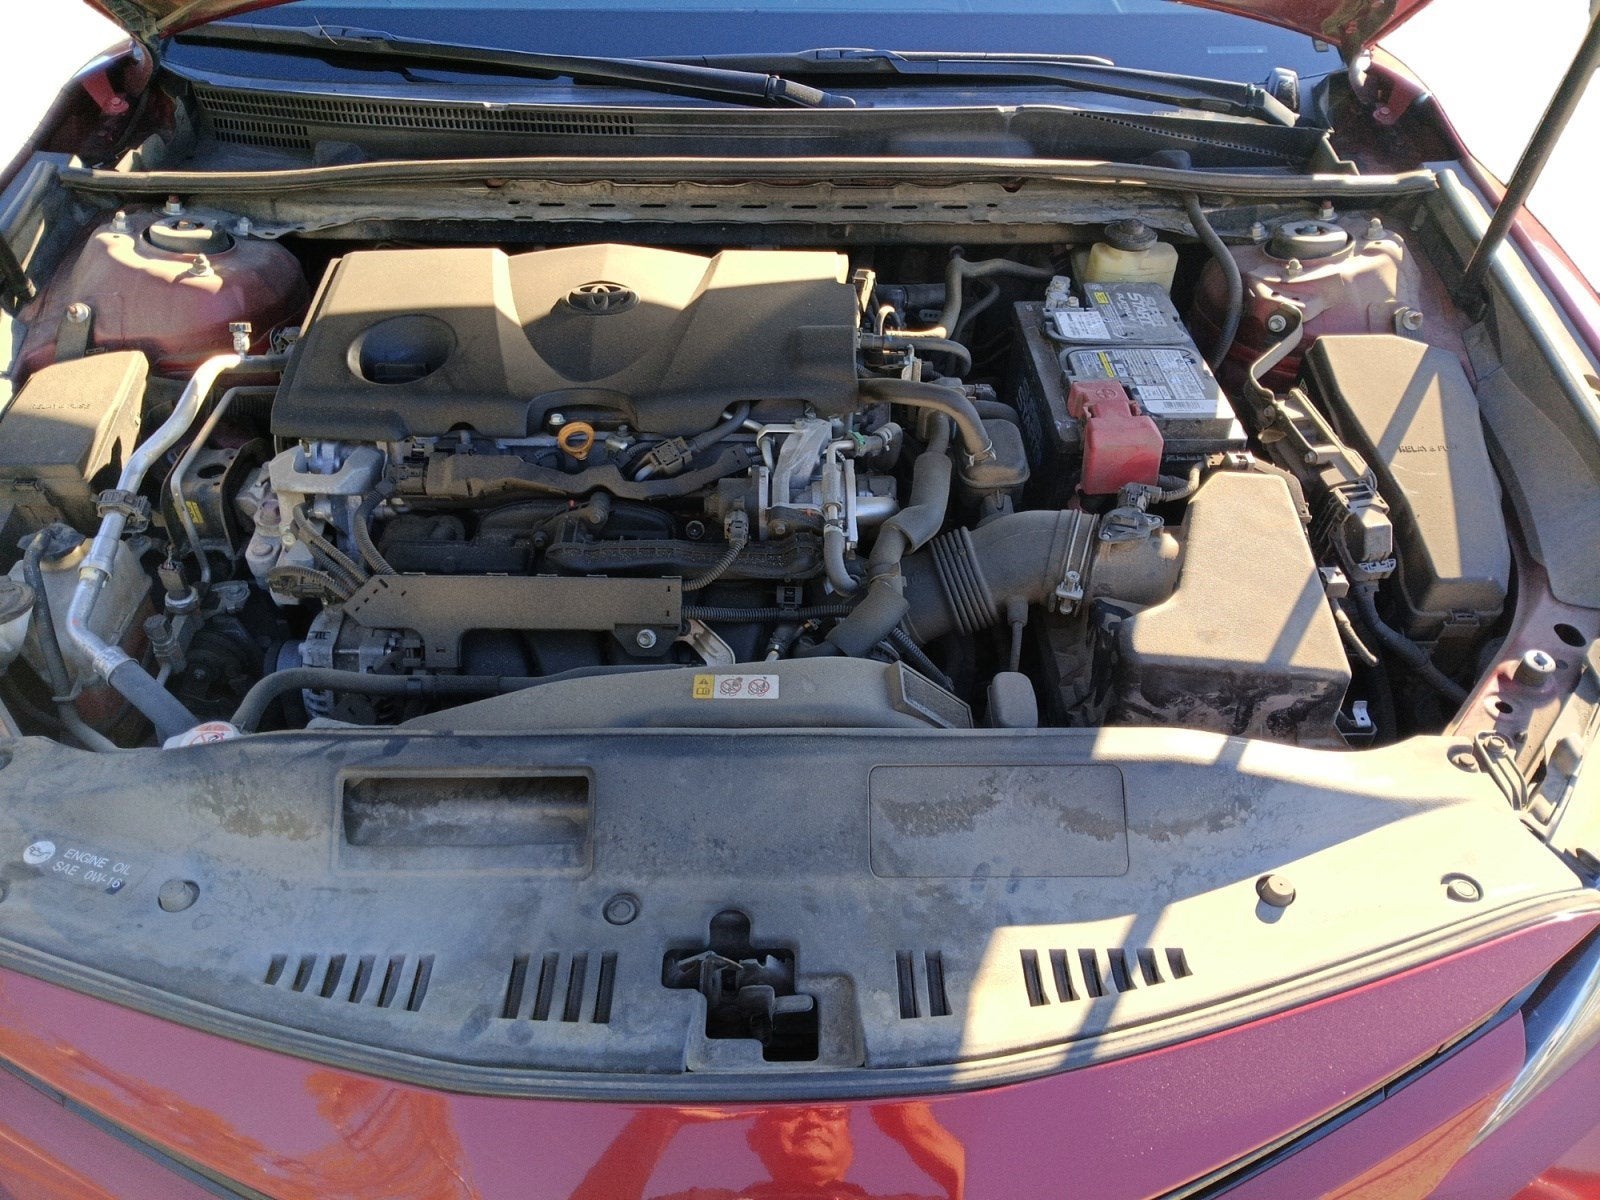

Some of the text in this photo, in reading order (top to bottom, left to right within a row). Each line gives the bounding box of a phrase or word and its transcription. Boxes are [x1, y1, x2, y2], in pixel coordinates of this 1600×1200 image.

[1126, 292, 1153, 326] START
[52, 861, 80, 876] SAE
[63, 848, 131, 876] ENGINE OIL
